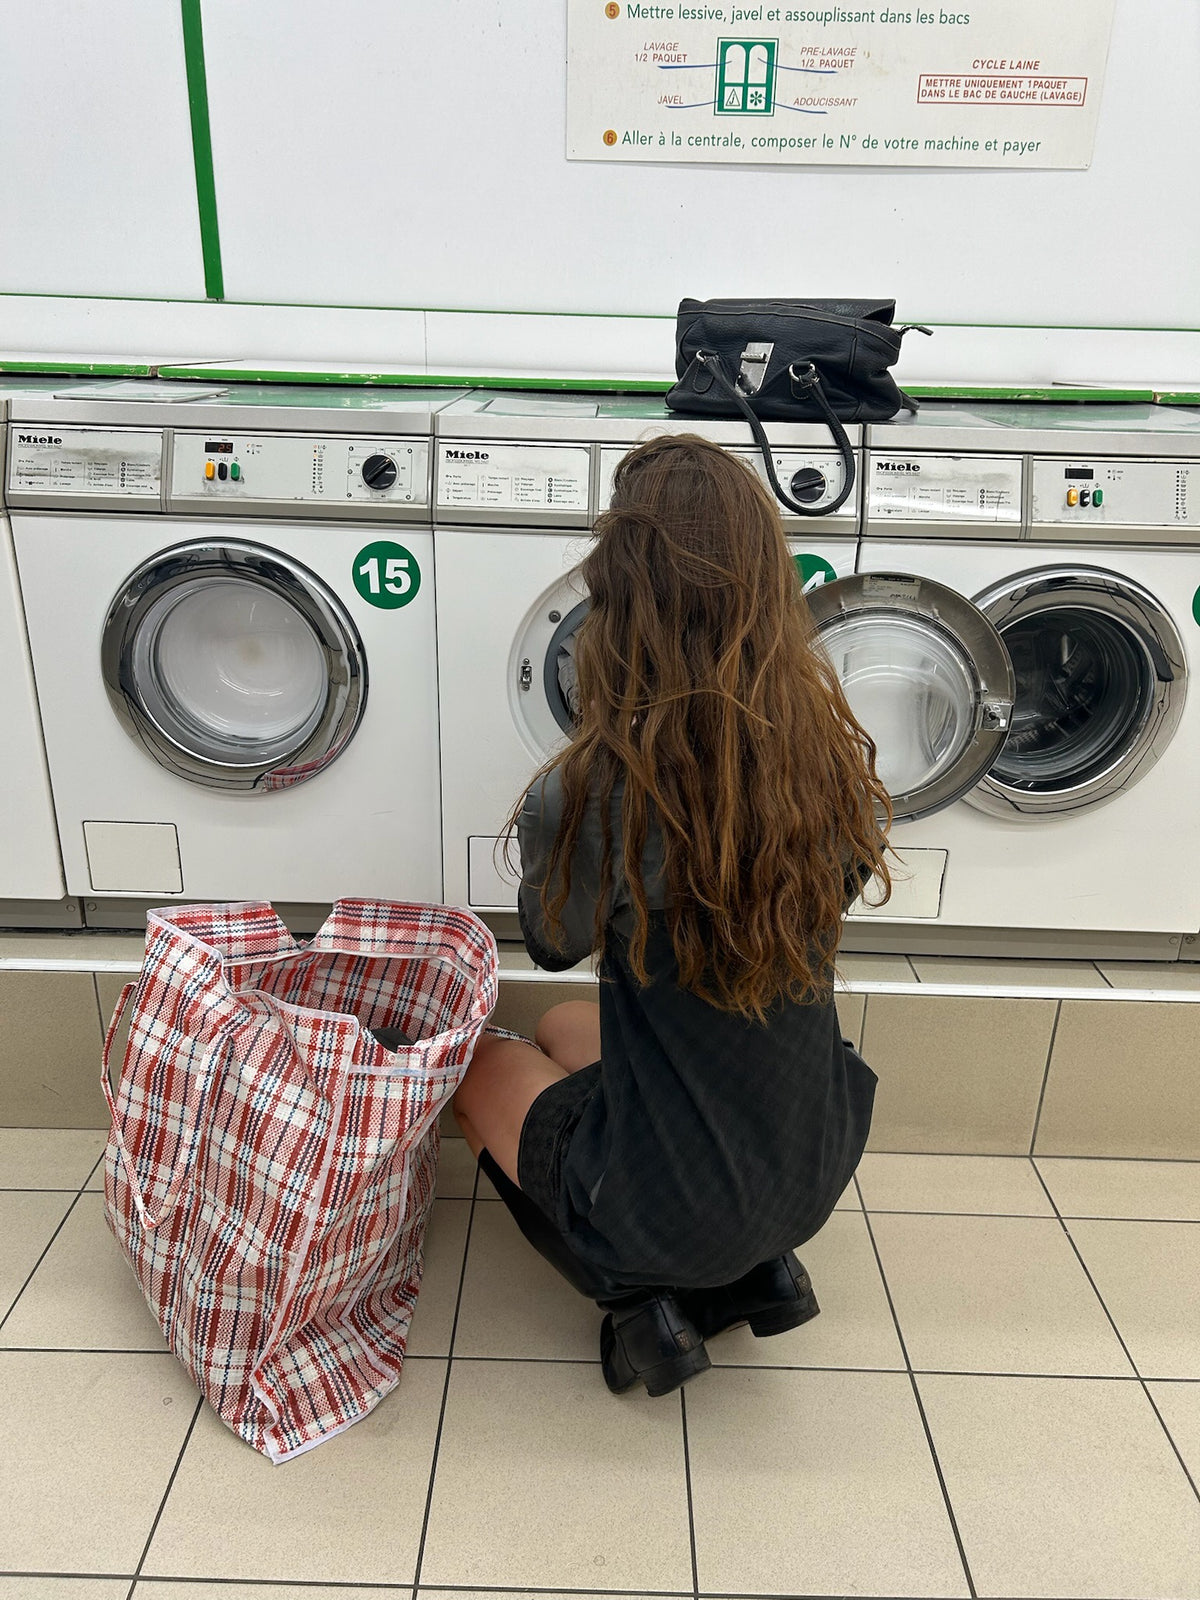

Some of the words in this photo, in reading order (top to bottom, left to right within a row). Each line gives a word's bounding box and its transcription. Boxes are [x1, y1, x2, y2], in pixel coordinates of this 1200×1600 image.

[608, 4, 617, 17] 5
[627, 4, 674, 19] Mettre
[679, 3, 726, 22] lessive,
[730, 5, 762, 24] javel
[768, 8, 780, 21] et
[785, 6, 875, 27] assouplissant
[880, 8, 911, 23] dans
[916, 8, 934, 24] les
[939, 9, 969, 24] bacs
[644, 42, 679, 51] LAVAGE
[801, 47, 857, 56] PRE-LAVAGE
[635, 53, 647, 62] 1/2
[653, 53, 687, 62] PAQUET
[802, 59, 814, 67] 1/2
[820, 59, 854, 68] PAQUET
[973, 59, 1005, 69] CYCLE
[1009, 60, 1040, 70] LAINE
[926, 79, 961, 88] METTRE
[964, 80, 1023, 89] UNIQUEMENT
[658, 95, 683, 104] JAVEL
[921, 89, 945, 98] DANS
[949, 90, 959, 98] LE
[963, 90, 981, 98] BAC
[985, 90, 995, 98] DE
[1000, 90, 1037, 99] GAUCHE
[1040, 92, 1083, 102] (LAVAGE)
[793, 97, 858, 106] ADOUCISSANT
[606, 131, 615, 145] 6
[622, 130, 653, 145] Aller
[659, 131, 665, 145] à
[672, 131, 681, 146] la
[688, 132, 745, 149] centrale,
[752, 137, 817, 152] composer
[823, 133, 833, 148] le
[840, 135, 856, 148] N°
[862, 134, 878, 149] de
[884, 137, 918, 150] votre
[925, 136, 979, 151] machine
[985, 139, 998, 151] et
[1003, 141, 1041, 156] payer
[18, 435, 63, 444] Miele
[446, 450, 489, 460] Miele
[876, 462, 921, 472] Miele
[359, 558, 414, 595] 15
